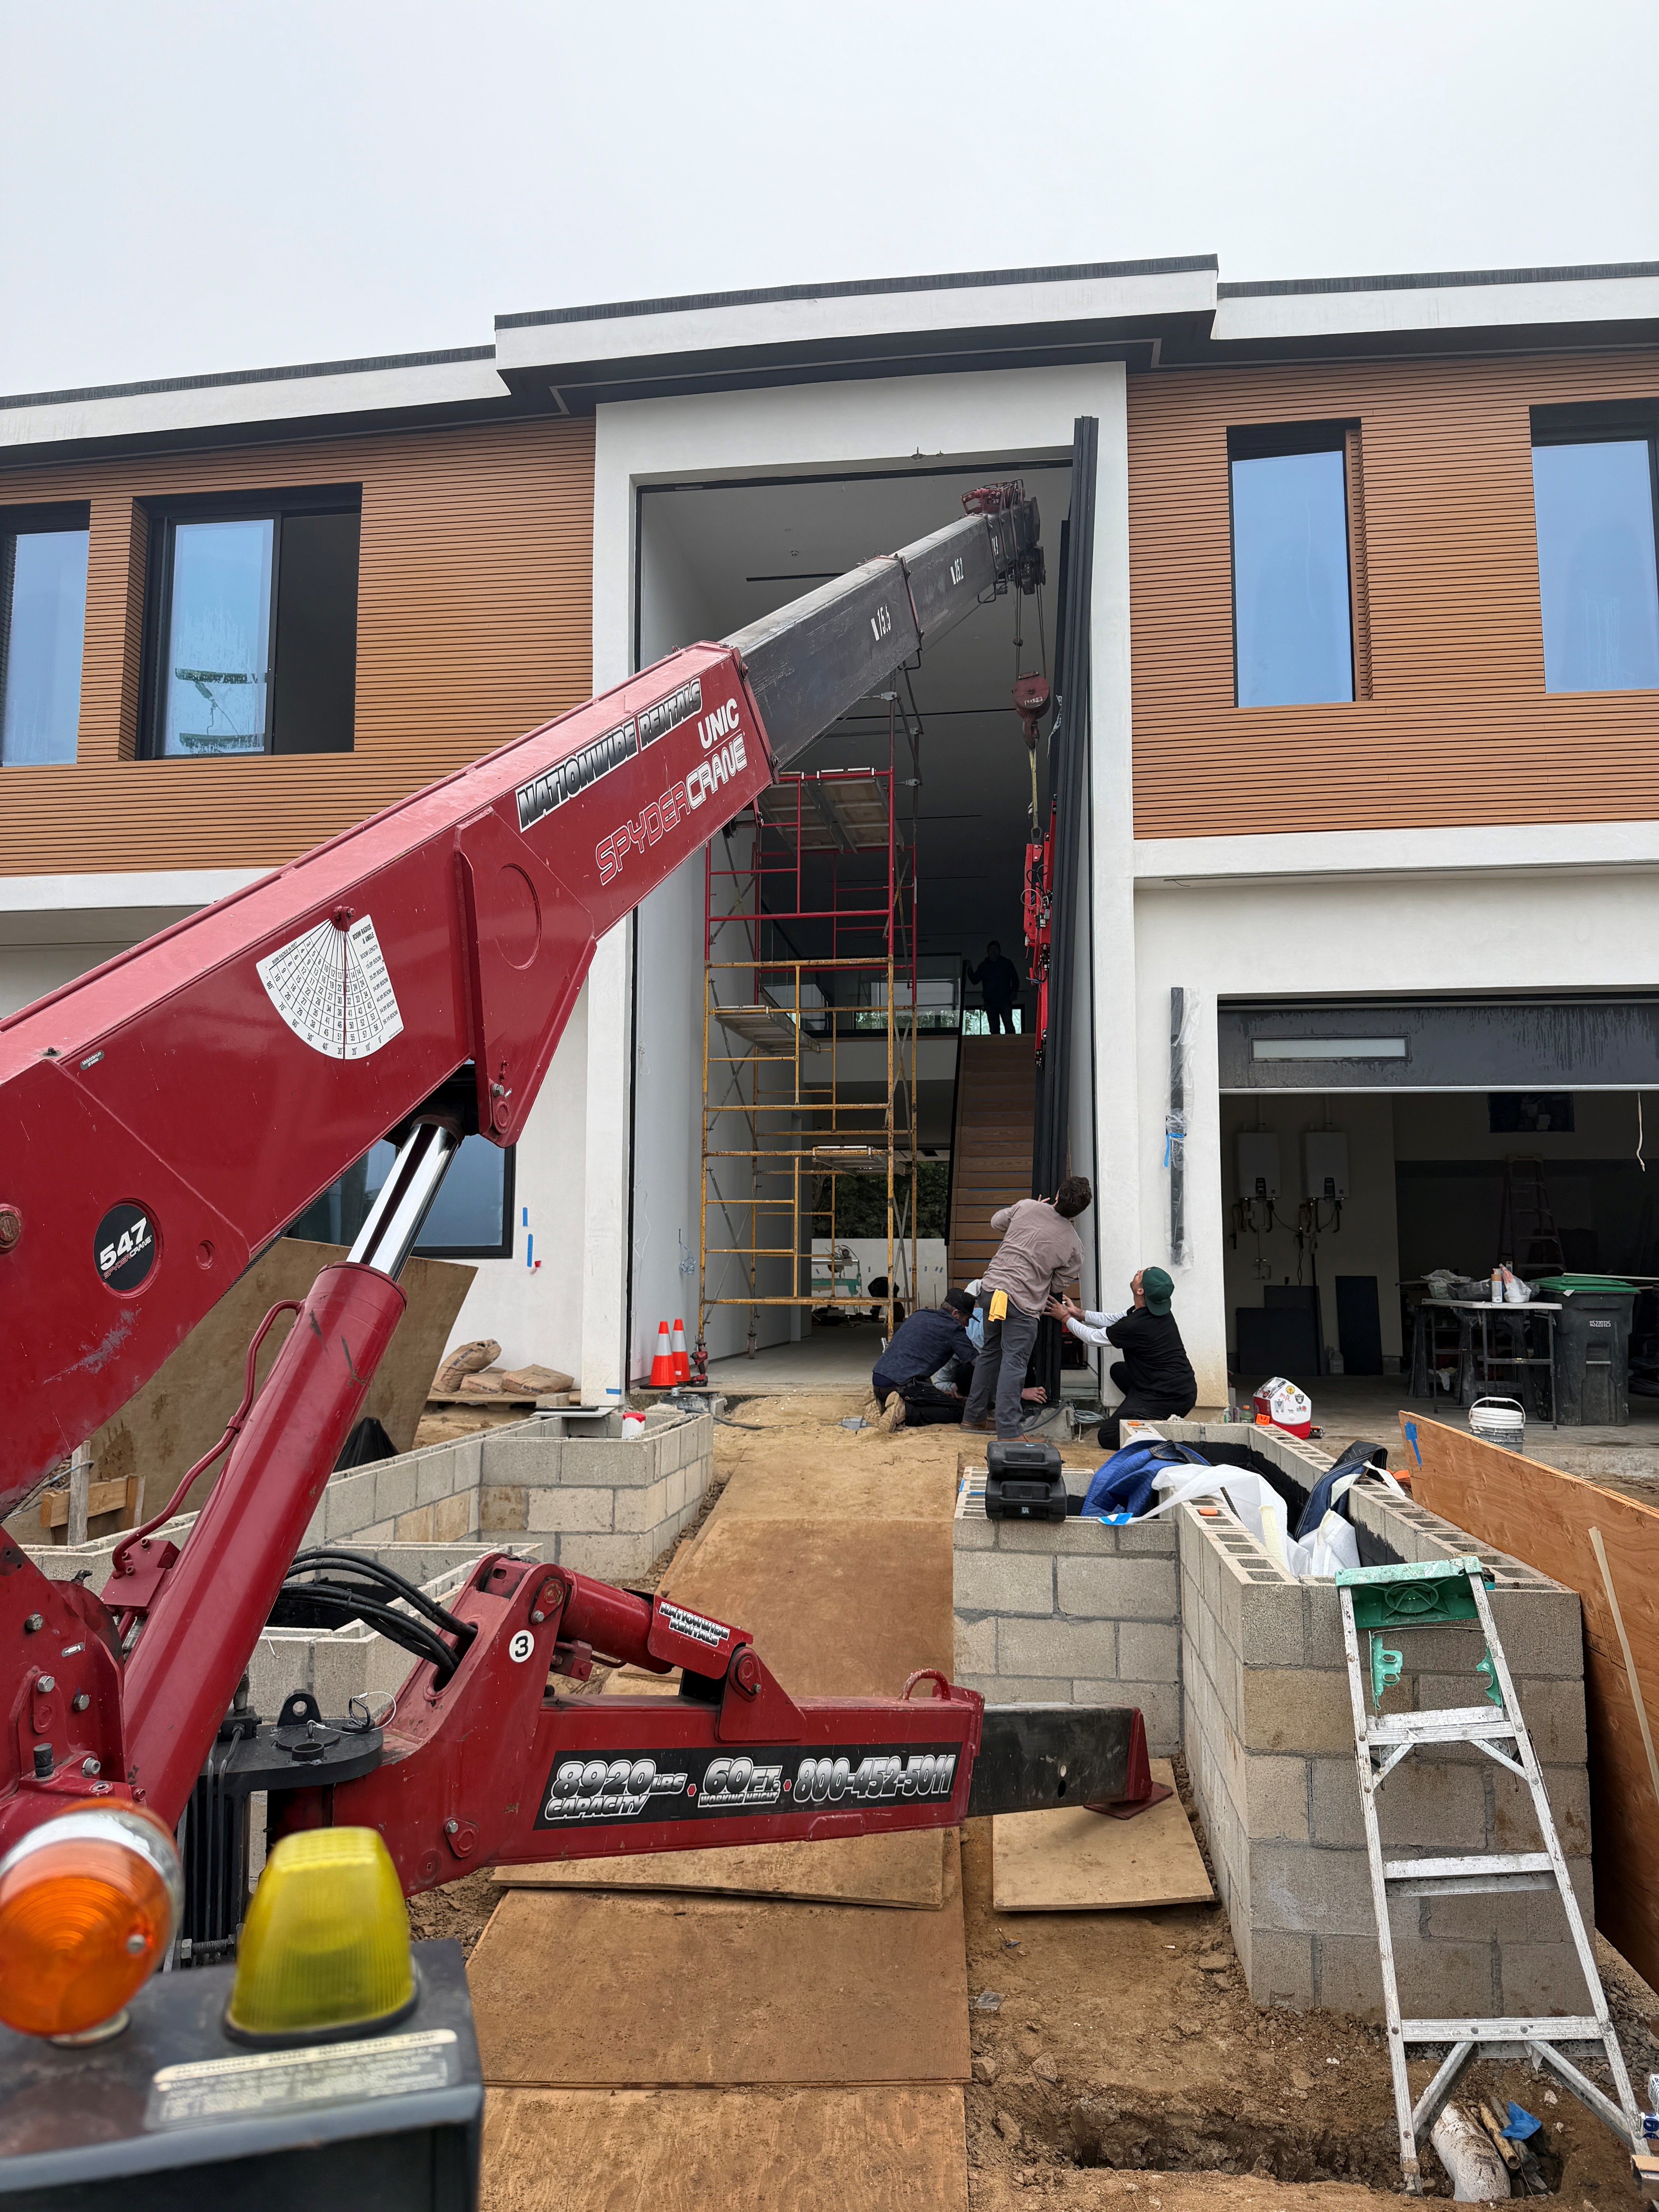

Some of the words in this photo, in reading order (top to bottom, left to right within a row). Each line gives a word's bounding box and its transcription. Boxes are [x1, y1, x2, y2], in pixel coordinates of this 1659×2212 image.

[954, 557, 964, 583] 25.2
[877, 603, 891, 637] 15.5
[698, 698, 740, 749] UNIC
[517, 720, 638, 830] NATIONWIDE
[639, 679, 702, 749] RENTALS
[352, 931, 362, 941] BOOM
[301, 966, 306, 975] 12
[309, 977, 315, 986] 17
[318, 986, 324, 995] 22
[328, 993, 333, 1001] 27
[313, 967, 318, 976] 13
[321, 975, 326, 984] 16
[330, 981, 334, 989] 19
[353, 983, 358, 991] 24
[360, 979, 365, 988] 24
[324, 964, 328, 972] 10
[331, 969, 335, 977] 12
[350, 971, 355, 979] 14
[357, 968, 361, 976] 14
[275, 973, 281, 982] 10
[285, 992, 291, 1001] 20
[297, 1007, 303, 1016] 29
[324, 1029, 329, 1037] 45
[362, 1030, 367, 1038] 57
[290, 983, 296, 992] 18
[301, 997, 307, 1006] 27
[313, 1008, 318, 1017] 35
[325, 1017, 330, 1025] 41
[360, 1018, 365, 1027] 52
[296, 975, 301, 983] 15
[305, 987, 311, 996] 22
[326, 1005, 331, 1013] 34
[100, 1217, 147, 1271] 547
[659, 1602, 730, 1641] NATIONWIDE
[669, 1618, 720, 1647] RENTALS
[515, 1635, 529, 1658] 3
[793, 1754, 957, 1804] 800-452-5011
[544, 1794, 649, 1821] CAPACITY
[698, 1792, 744, 1808] WORKING
[744, 1790, 778, 1806] HEIGHT
